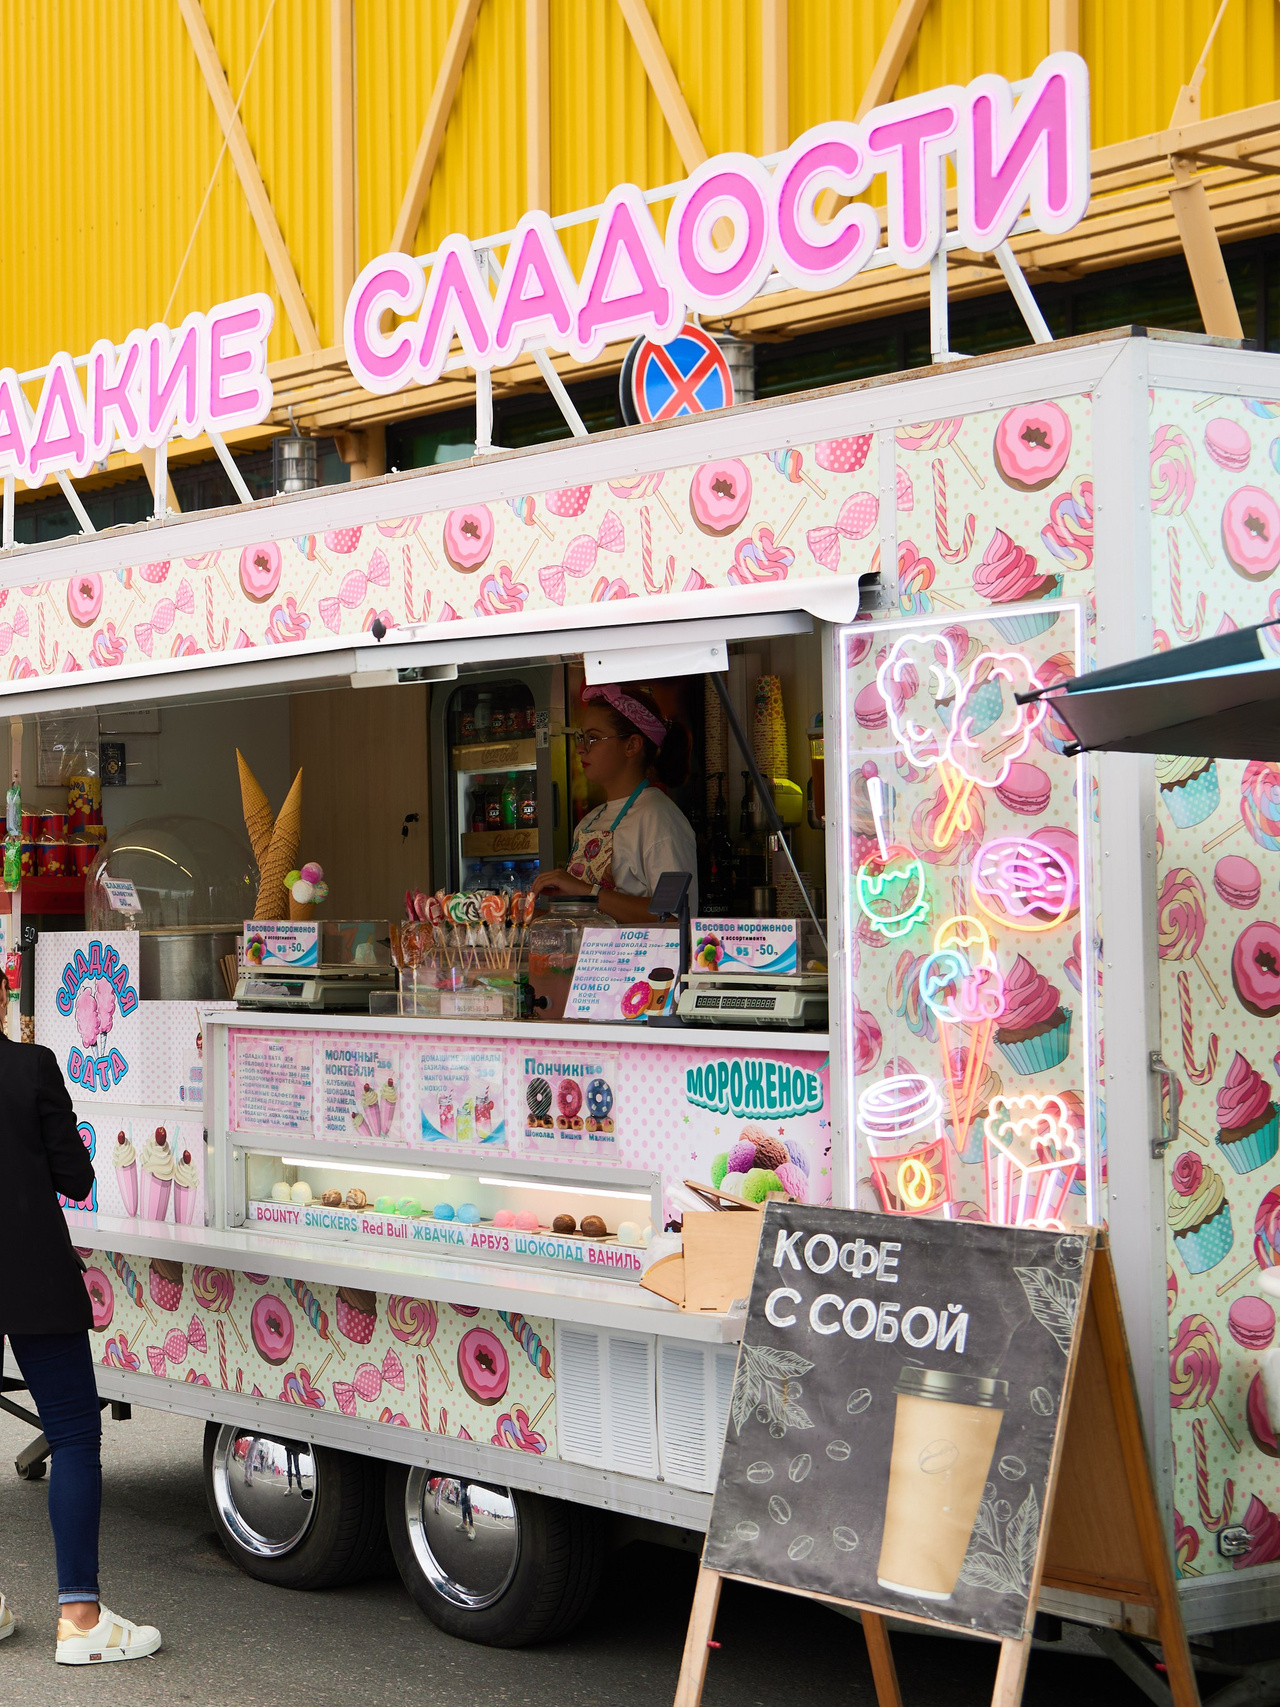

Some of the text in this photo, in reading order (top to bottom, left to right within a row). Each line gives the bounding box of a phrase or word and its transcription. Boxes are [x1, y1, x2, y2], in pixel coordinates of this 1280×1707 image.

[343, 52, 1089, 394] СЛАДОСТИ
[246, 923, 316, 934] Весовое мороженое
[695, 922, 793, 934] Весовое мороженое
[620, 931, 650, 940] КОФЕ
[735, 946, 749, 956] 95
[56, 940, 138, 1017] СЛАДКАЯ
[573, 983, 610, 991] КОМБО
[67, 1046, 129, 1092] ВАТА
[325, 1063, 374, 1077] КОКТЕЙЛИ
[377, 1061, 392, 1069] 250
[686, 1058, 821, 1114] МОРОЖЕНОЕ
[525, 1129, 615, 1143] Шоколад Вишня Малина
[256, 1206, 641, 1271] BOUNTY SNICKERS Red Bull ЖВАЧКА АРБУЗ ШОКОЛАД ВАНИЛЬ
[773, 1229, 902, 1283] КОФЕ
[765, 1287, 969, 1354] С СОБОЙ
